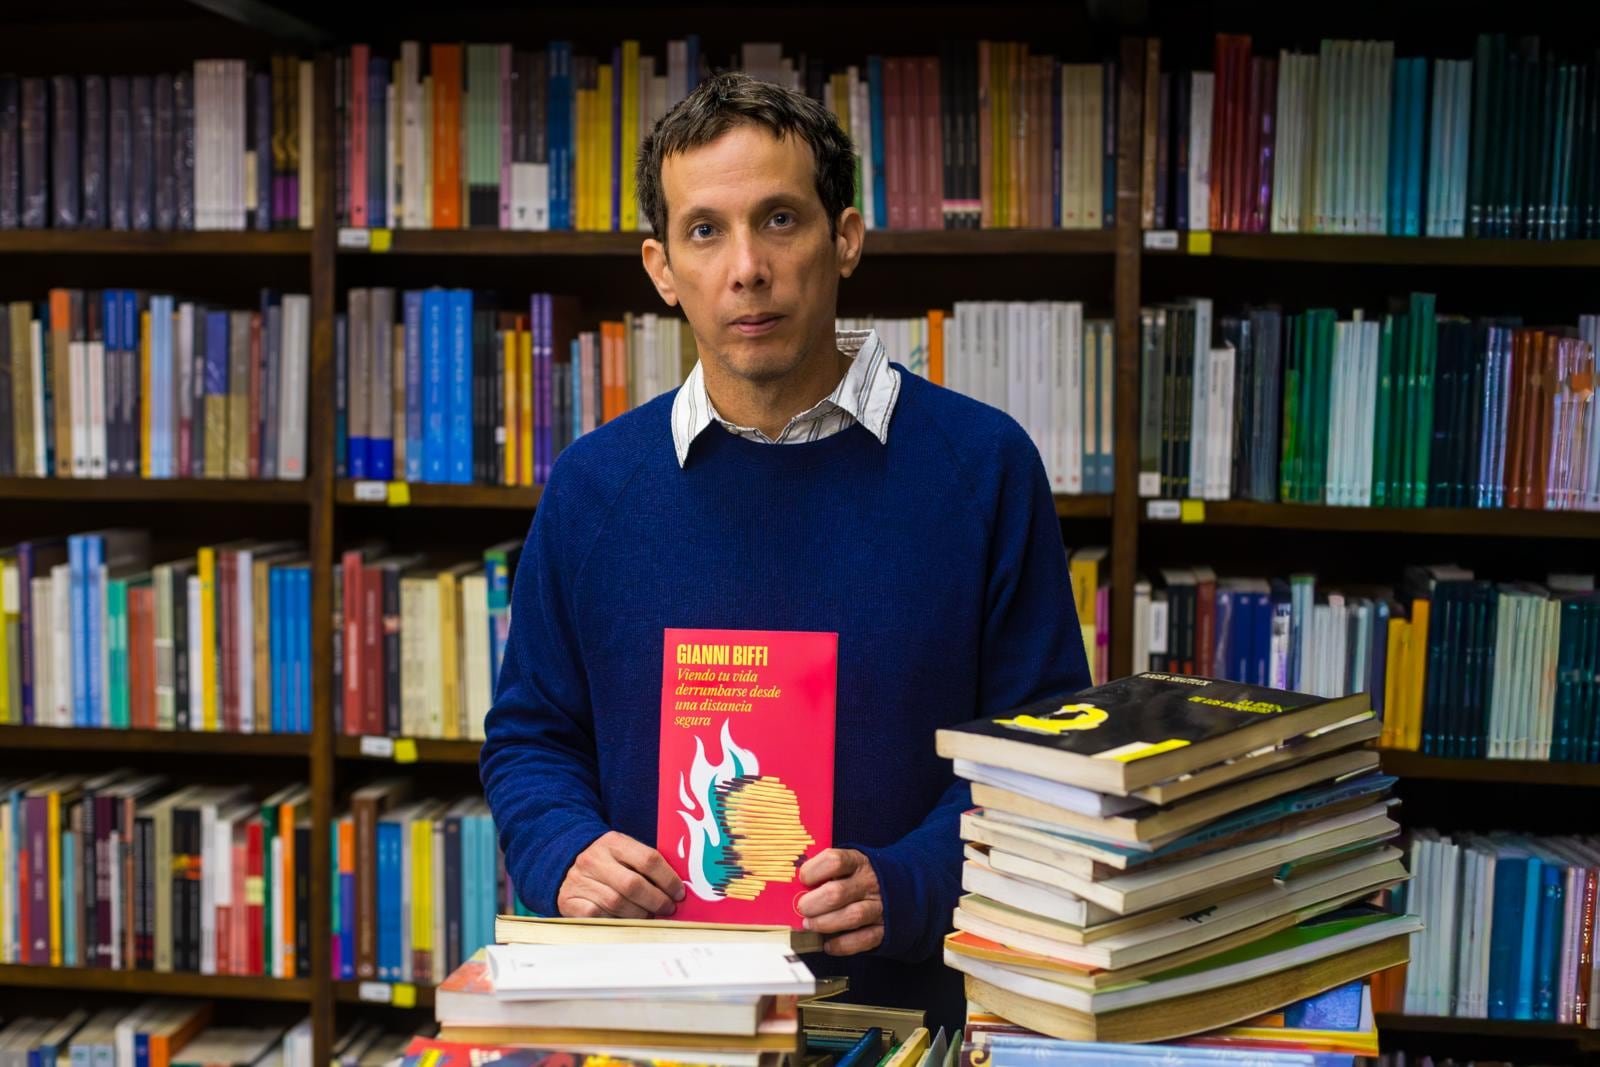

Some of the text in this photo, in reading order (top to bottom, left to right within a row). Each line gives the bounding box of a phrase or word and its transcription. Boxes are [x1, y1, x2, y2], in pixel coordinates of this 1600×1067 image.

[677, 643, 768, 667] GIANNI BIFFI
[677, 667, 758, 683] Viendo tu vida
[675, 682, 781, 697] derrumbarse desde
[675, 698, 753, 713] una distancia
[674, 715, 711, 728] segura
